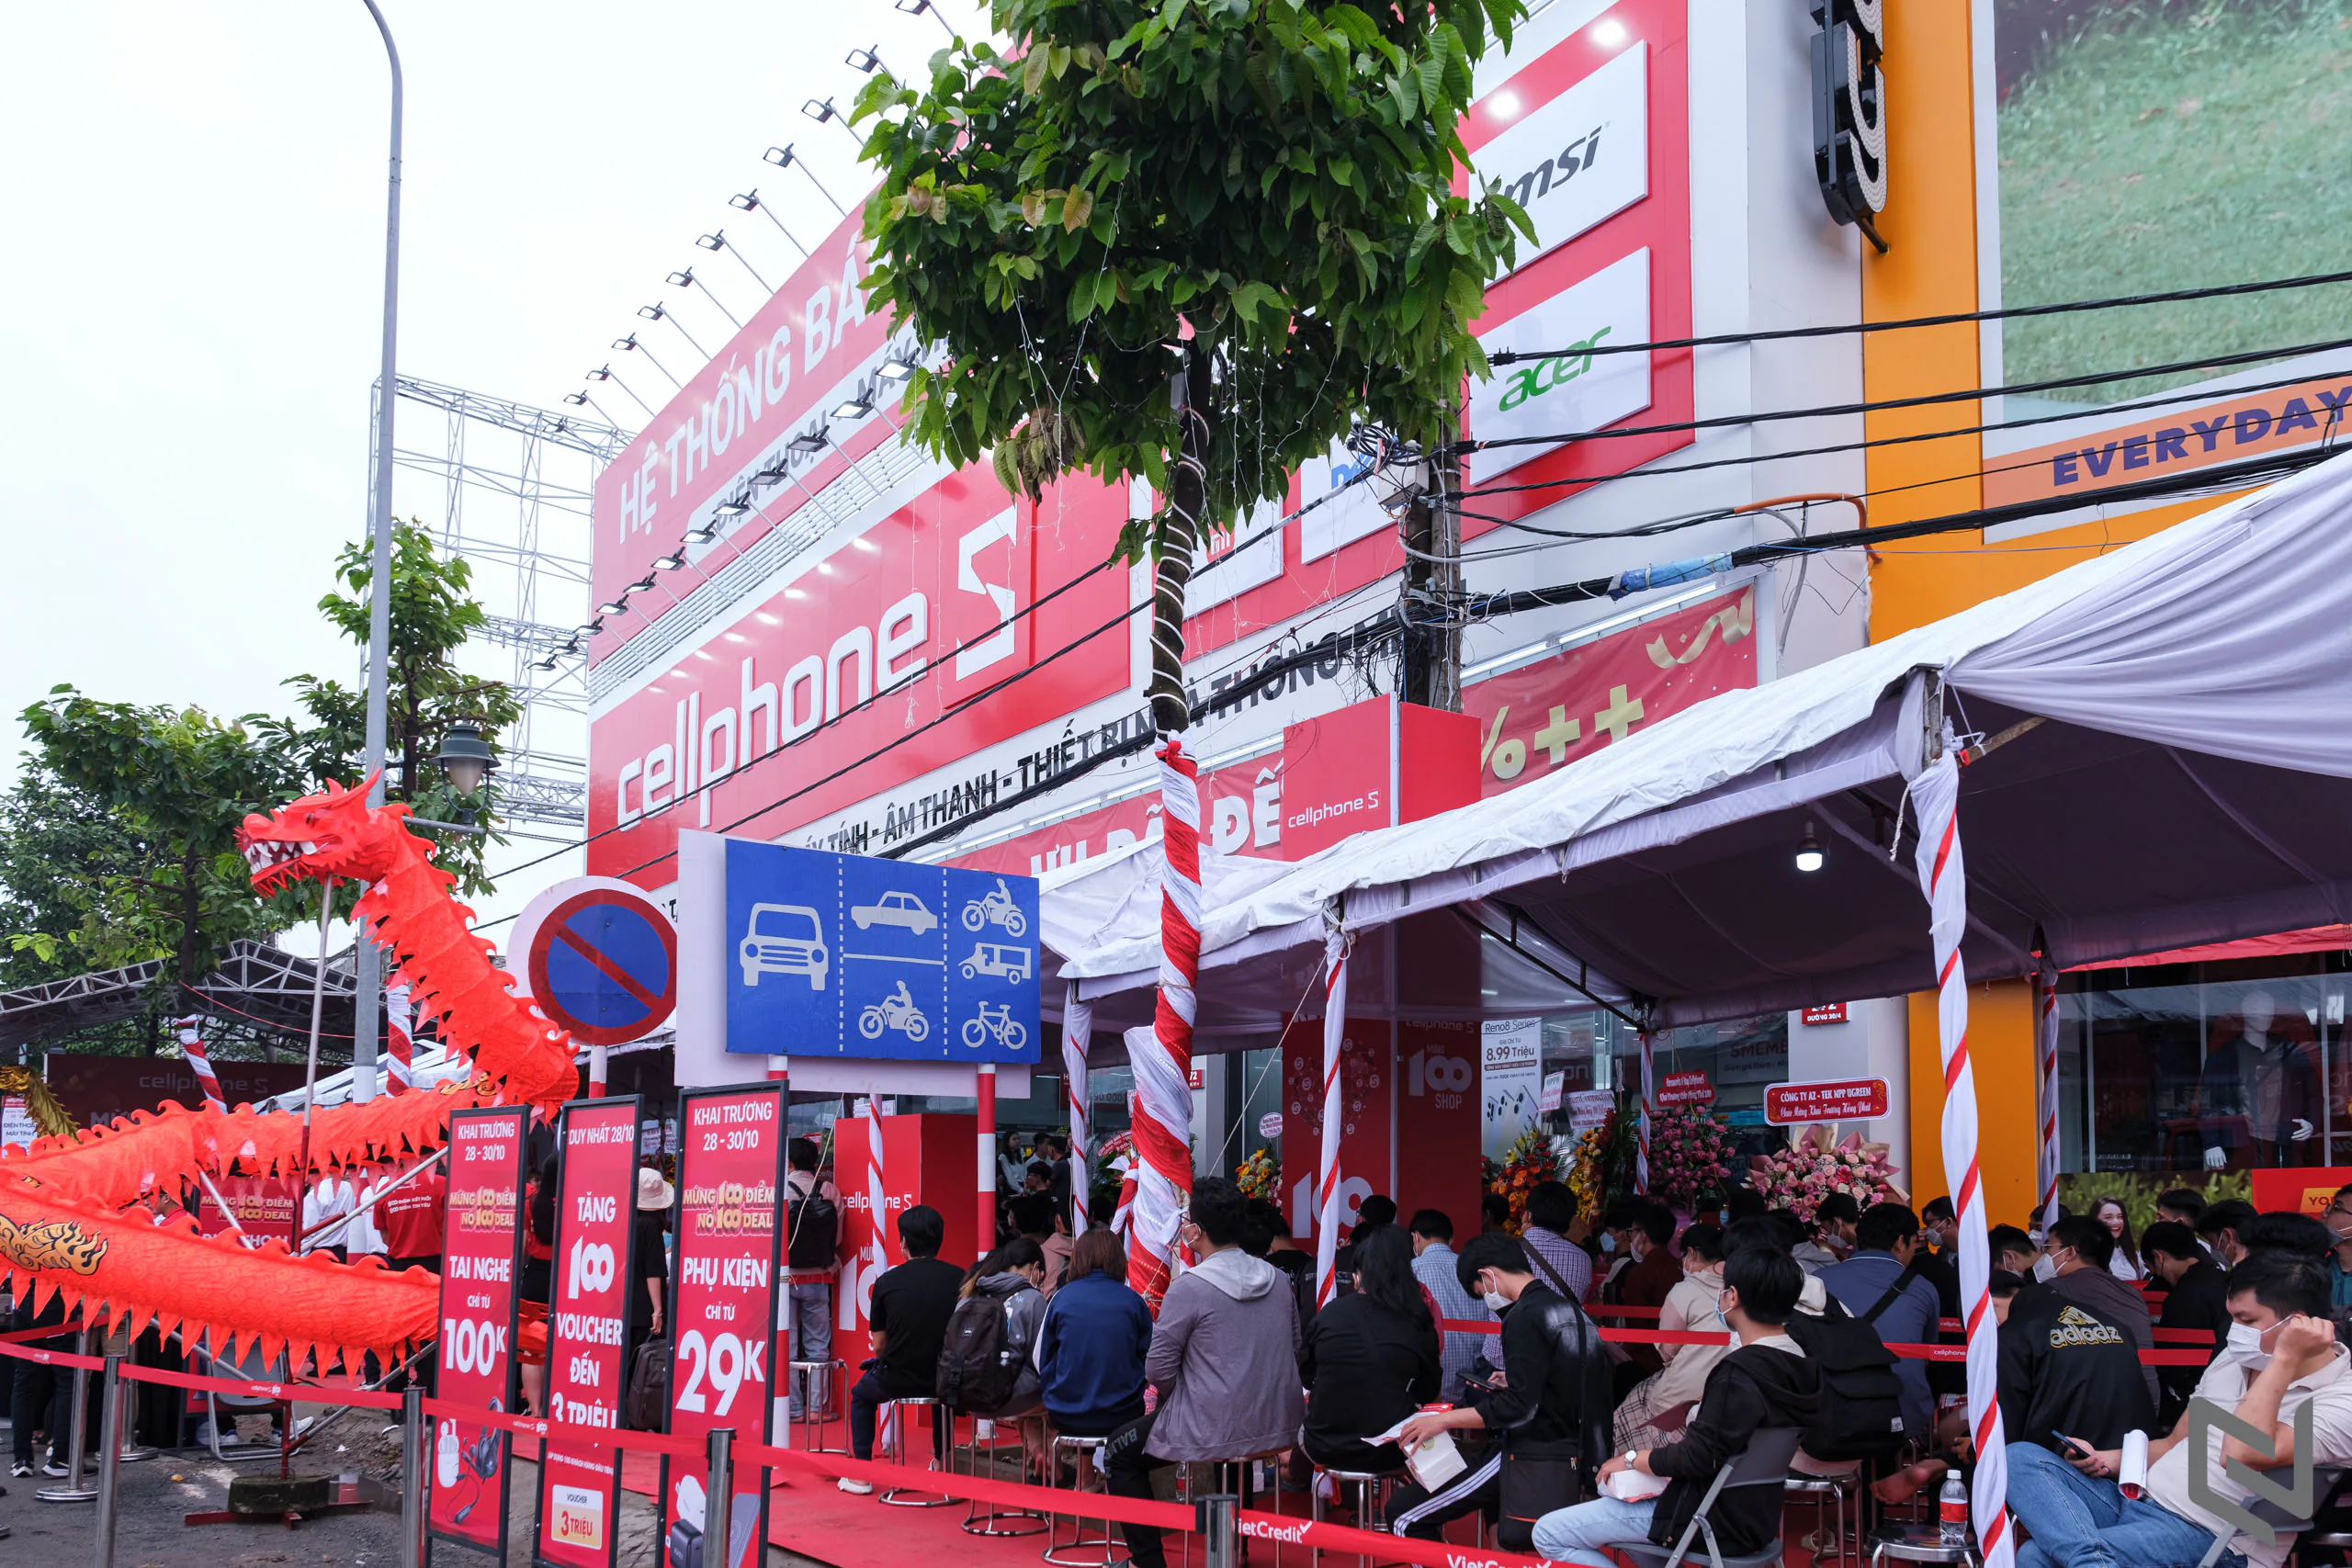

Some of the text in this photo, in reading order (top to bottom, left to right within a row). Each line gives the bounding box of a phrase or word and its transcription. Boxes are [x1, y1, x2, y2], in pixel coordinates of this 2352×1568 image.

[1504, 126, 1602, 209] msi
[1499, 325, 1611, 412] acer
[619, 445, 659, 544] HỆ
[665, 324, 791, 498] THỐNG
[2053, 385, 2352, 487] EVERYDAY
[617, 592, 930, 832] cellphone
[883, 802, 915, 846] ÂM
[919, 769, 997, 830] THANH
[1018, 718, 1094, 792] THIẾT
[1210, 757, 1283, 855] ĐẾ
[1288, 796, 1363, 828] cellphone
[1485, 1019, 1536, 1033] Reno8 Series
[1486, 1045, 1535, 1061] 8.99 Triệu
[139, 1073, 248, 1093] cellphne
[1408, 1048, 1473, 1097] 100
[1435, 1093, 1463, 1110] SHOP
[1780, 1091, 1799, 1102] CÔNG
[1799, 1091, 1807, 1101] TY
[1808, 1090, 1816, 1100] AZ
[1821, 1089, 1833, 1100] TEK
[1833, 1089, 1847, 1099] NPP
[1847, 1087, 1871, 1098] UGREEN
[694, 1100, 772, 1125] KHAI TRƯƠNG
[458, 1120, 514, 1140] KHAI TRƯƠNG
[569, 1128, 586, 1145] DUY
[588, 1122, 610, 1145] NHẤT
[611, 1123, 634, 1143] 28/10
[704, 1133, 718, 1151] 28
[727, 1128, 759, 1150] 30/10
[465, 1145, 476, 1161] 28
[482, 1143, 505, 1161] 30/10
[718, 1180, 743, 1206] 100
[842, 1191, 900, 1213] ellpne
[577, 1194, 616, 1224] TẶNG
[743, 1213, 774, 1228] DEAL
[449, 1255, 511, 1282] TAI NGHE
[568, 1235, 615, 1299] 100
[683, 1251, 768, 1294] PHỤ KIỆN
[706, 1303, 722, 1319] CHỈ
[556, 1313, 622, 1347] VOUCHER
[445, 1318, 507, 1377] 100K
[570, 1350, 600, 1387] ĐẾN
[676, 1329, 765, 1416] 29K
[567, 1493, 588, 1504] VOUCHER
[560, 1510, 593, 1538] 3 TRIỆU
[1238, 1518, 1303, 1544] ietCredit
[1446, 1553, 1531, 1568] VietC
